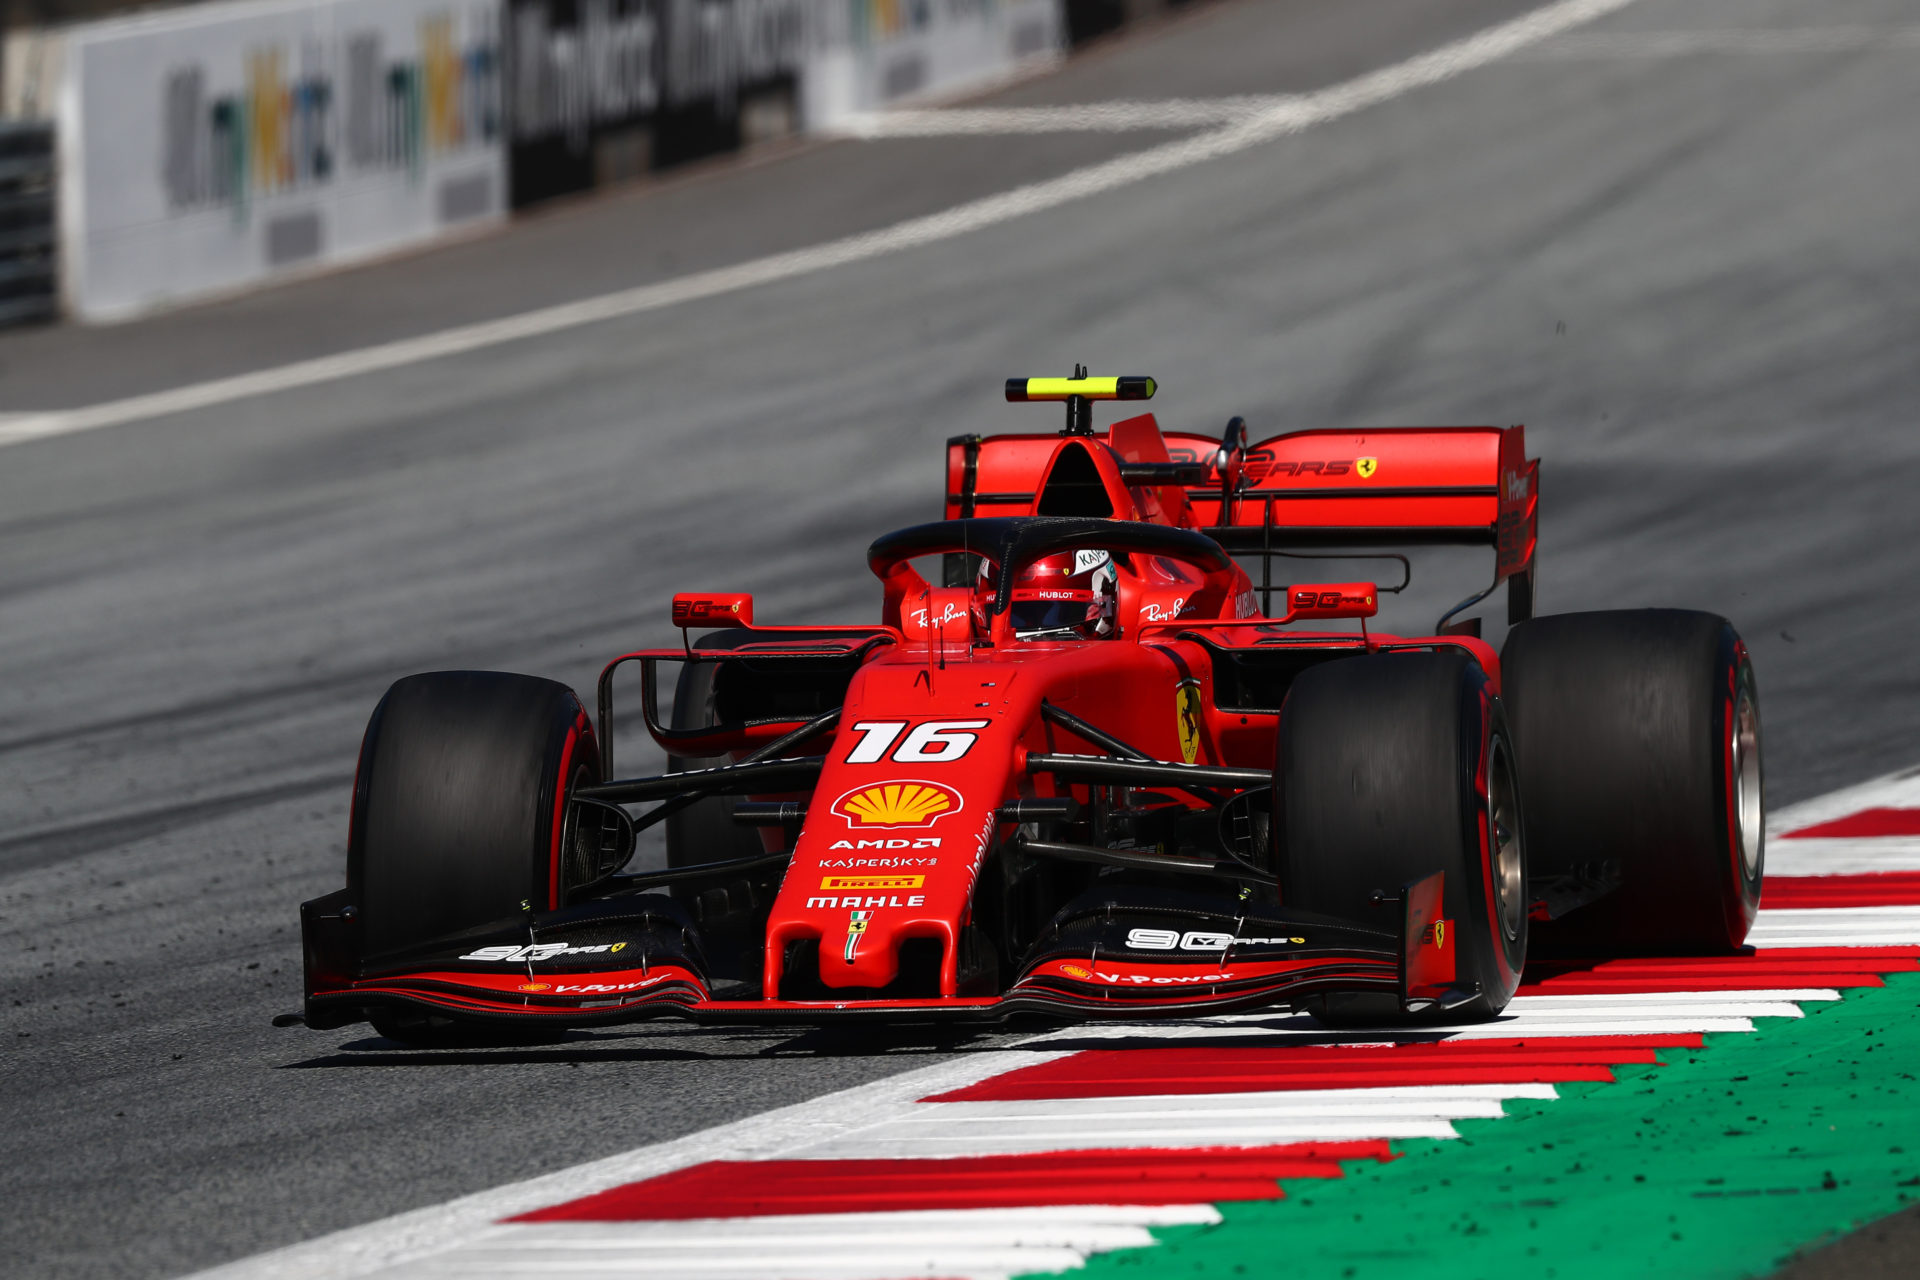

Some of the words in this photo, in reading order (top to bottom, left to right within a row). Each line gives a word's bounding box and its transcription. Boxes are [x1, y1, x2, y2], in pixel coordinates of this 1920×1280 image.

[1039, 591, 1074, 599] HUBLOT
[911, 603, 967, 629] Ray-Ban
[1140, 598, 1196, 621] Ray-Ban
[845, 719, 992, 764] 16
[829, 839, 911, 850] AMD
[819, 857, 928, 868] KASPERSKY
[829, 877, 916, 887] PIRELLI
[806, 895, 926, 909] MAHLE
[555, 973, 673, 993] V-Power
[1096, 972, 1235, 984] V-Power
